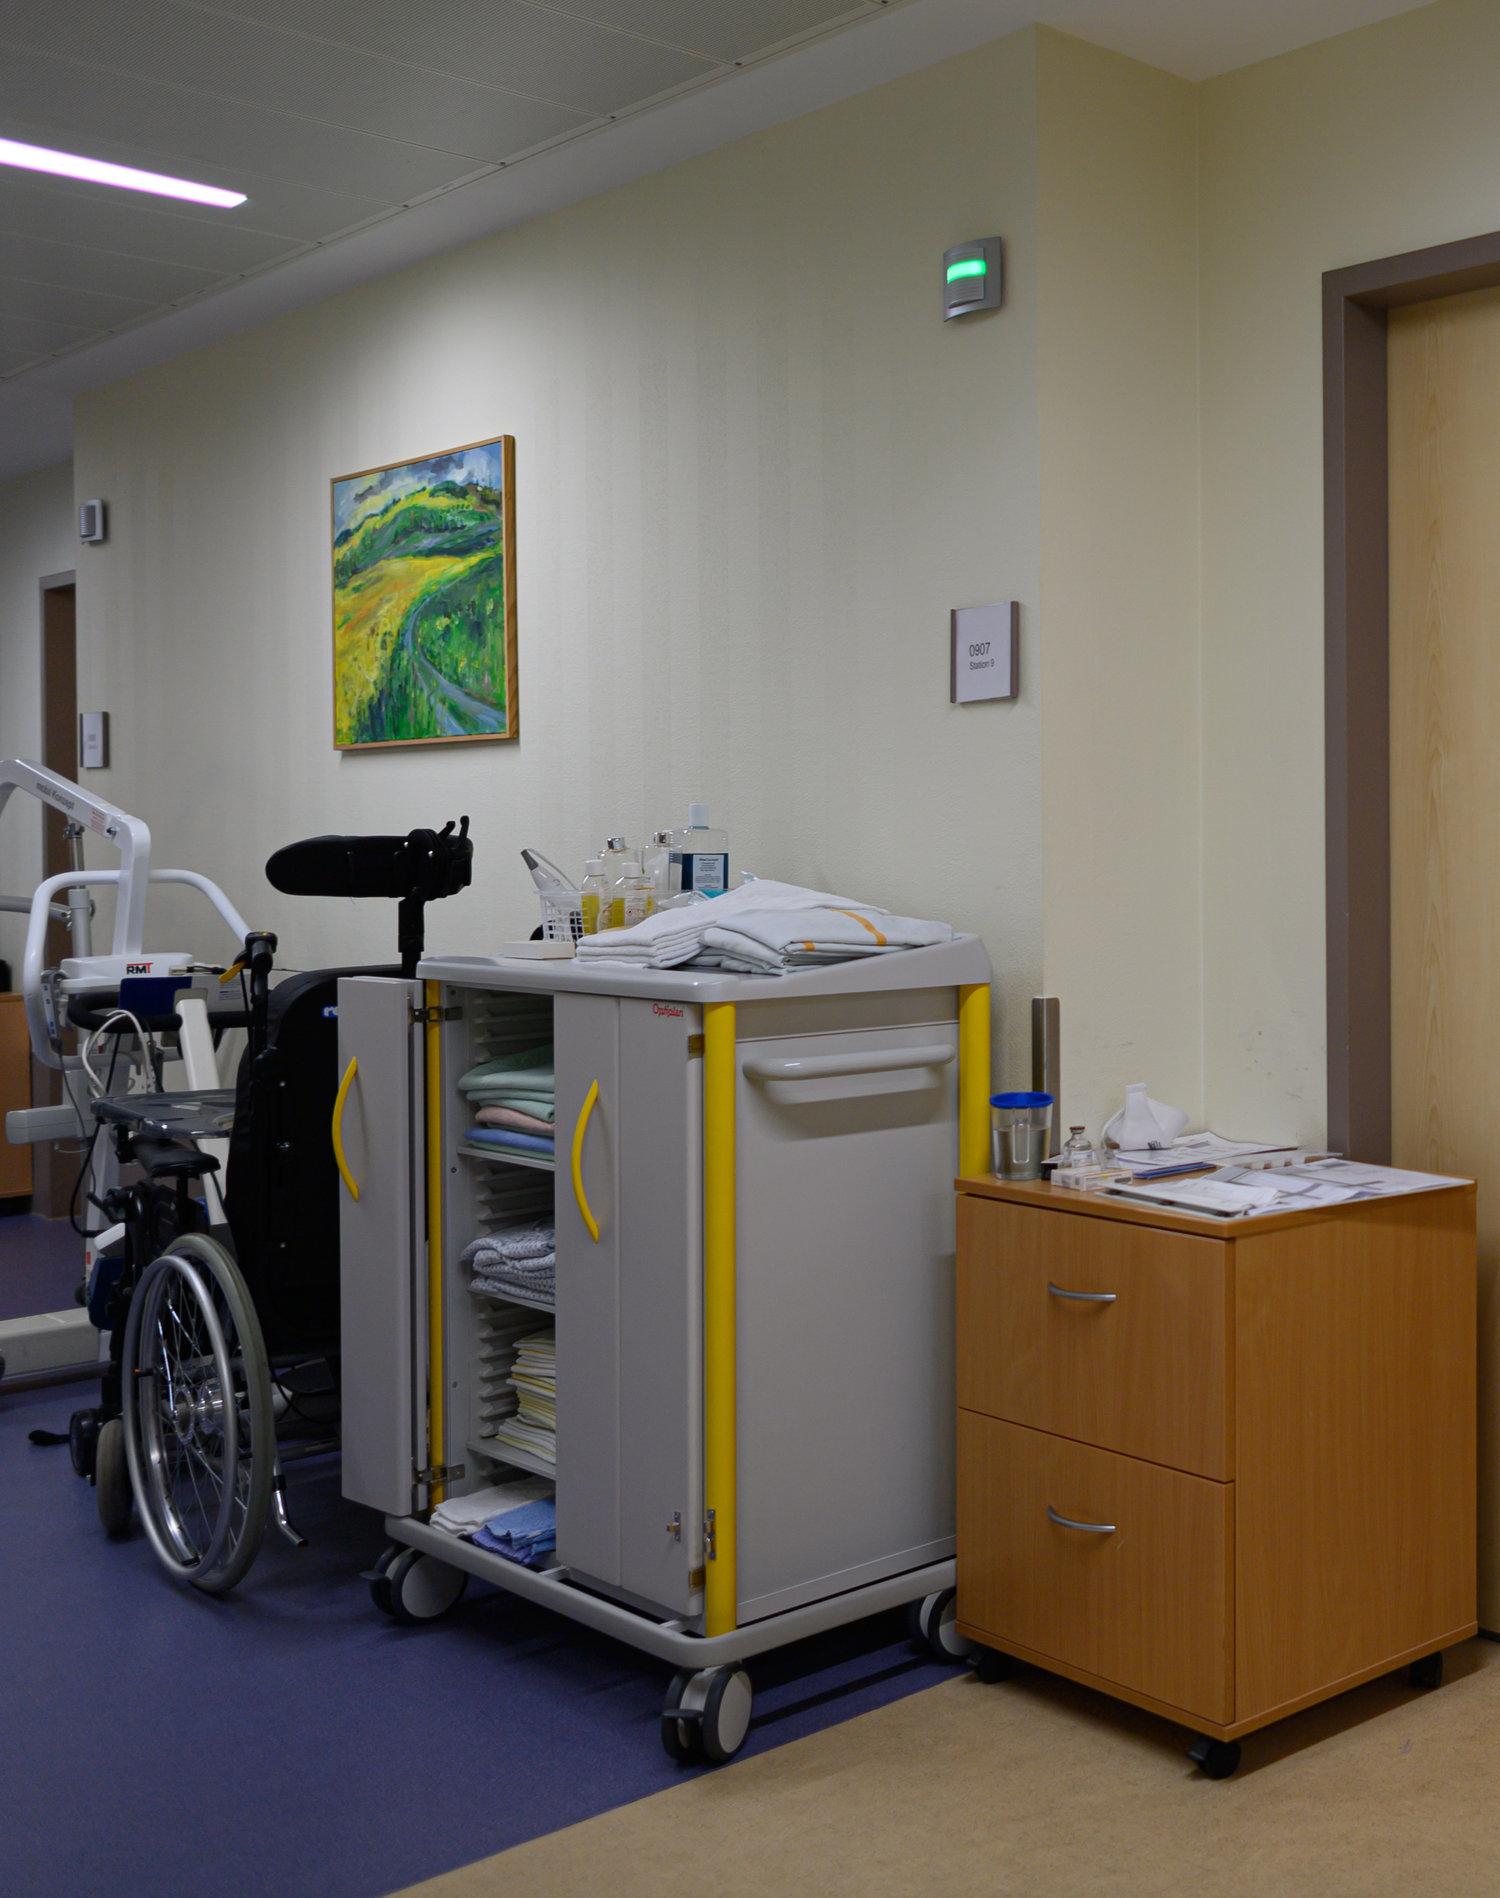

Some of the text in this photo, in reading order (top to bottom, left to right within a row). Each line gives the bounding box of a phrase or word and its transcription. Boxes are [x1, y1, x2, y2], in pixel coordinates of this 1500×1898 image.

[969, 642, 991, 657] 0907
[969, 661, 990, 670] Station
[126, 962, 153, 974] RMT
